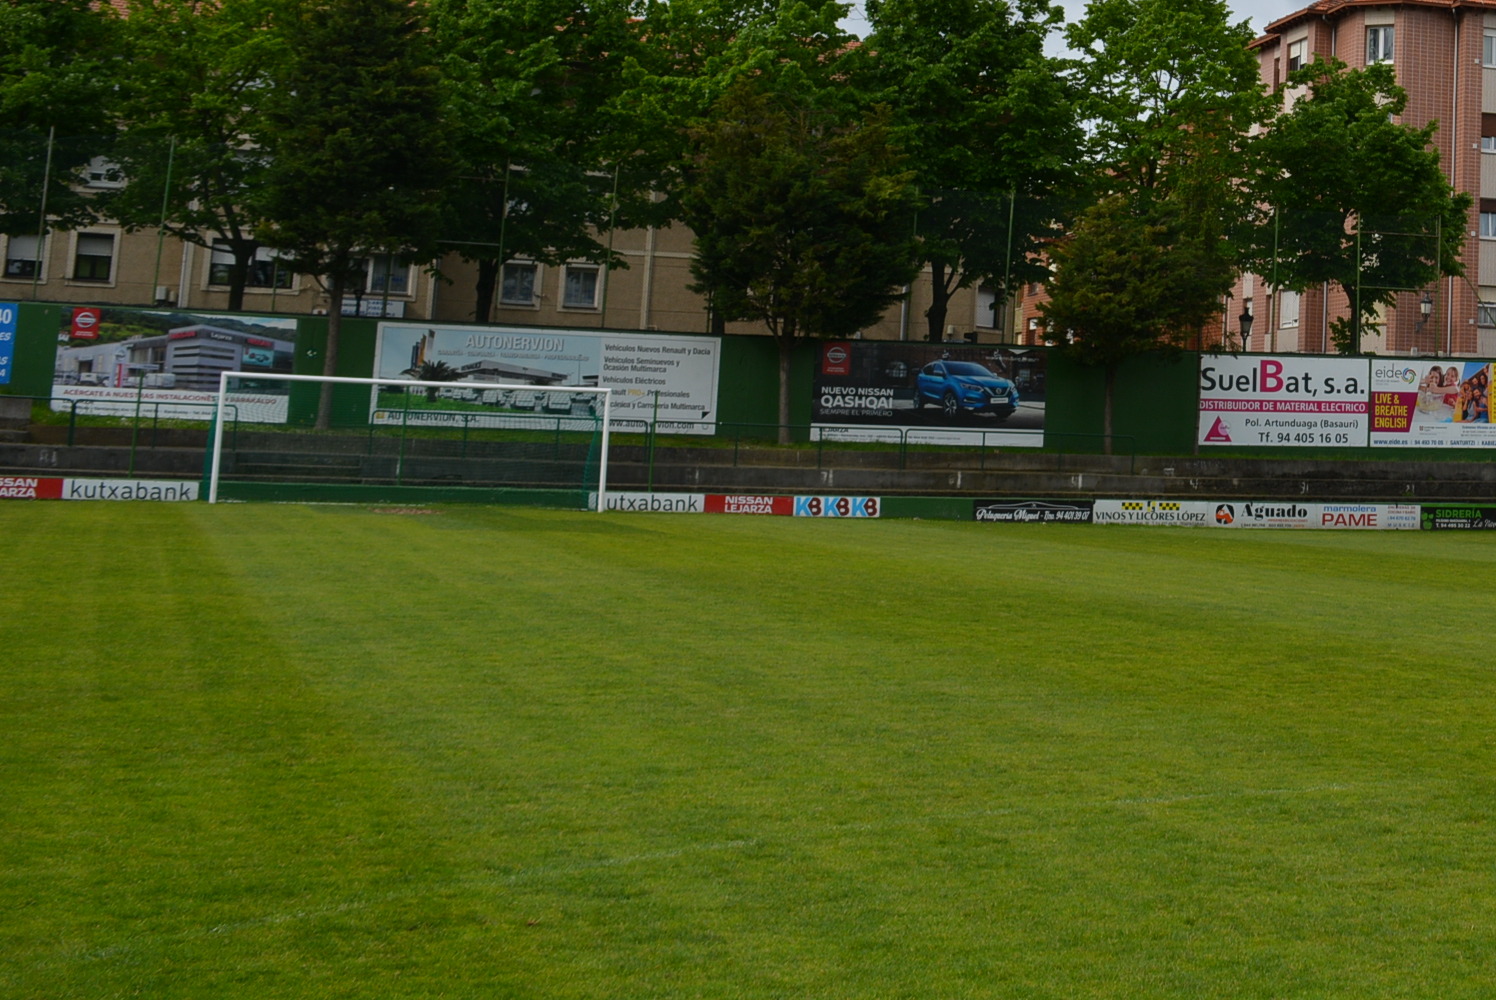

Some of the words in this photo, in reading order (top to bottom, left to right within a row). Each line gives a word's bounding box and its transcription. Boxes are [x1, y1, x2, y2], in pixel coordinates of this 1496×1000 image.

[0, 309, 12, 325] 0
[466, 335, 565, 352] AUTONERVION
[637, 344, 661, 353] Nuevos
[662, 346, 687, 354] Renault
[687, 348, 692, 356] y
[692, 347, 711, 355] Dacia
[636, 357, 675, 366] Seminuevos
[630, 365, 667, 373] Multimarca
[1375, 363, 1402, 379] eide
[1201, 359, 1318, 397] SuelBat,
[1323, 376, 1365, 395] s.a.
[821, 386, 856, 395] NUEVO
[857, 387, 894, 396] NISSAN
[820, 395, 893, 410] QASHQAI
[1375, 393, 1392, 404] LIVE
[1393, 394, 1400, 404] &
[670, 402, 706, 411] Multimarca
[1200, 401, 1261, 411] DISTRIBUIDOR
[1262, 401, 1274, 411] DE
[1276, 402, 1319, 411] MATERIAL
[1321, 402, 1366, 412] ELECTRICO
[1375, 405, 1408, 416] BREATHE
[820, 408, 850, 416] SIEMPRE
[861, 409, 893, 417] PRIMERO
[1245, 418, 1262, 427] Pol.
[1264, 419, 1318, 430] Artunduaga
[1320, 419, 1359, 429] (Basauri)
[1374, 417, 1407, 428] ENGLISH
[1258, 432, 1273, 443] Tf.
[1277, 432, 1291, 443] 94
[1294, 433, 1315, 443] 405
[1319, 433, 1332, 443] 16
[1335, 433, 1349, 444] 05
[70, 480, 192, 500] kutxabank
[725, 495, 773, 505] NISSAN
[724, 504, 773, 514] LEJARZA
[1323, 505, 1377, 513] marmolera
[1435, 508, 1482, 518] SIDRERÍA
[1014, 508, 1041, 522] Miguel
[1055, 511, 1063, 520] 94
[1064, 511, 1074, 520] 401
[1074, 511, 1081, 520] 39
[1082, 511, 1091, 520] 07
[1095, 511, 1126, 520] VINOS
[1128, 512, 1135, 520] Y
[1136, 511, 1175, 521] LICORES
[1177, 510, 1206, 521] LÓPEZ
[1322, 513, 1378, 527] PAME
